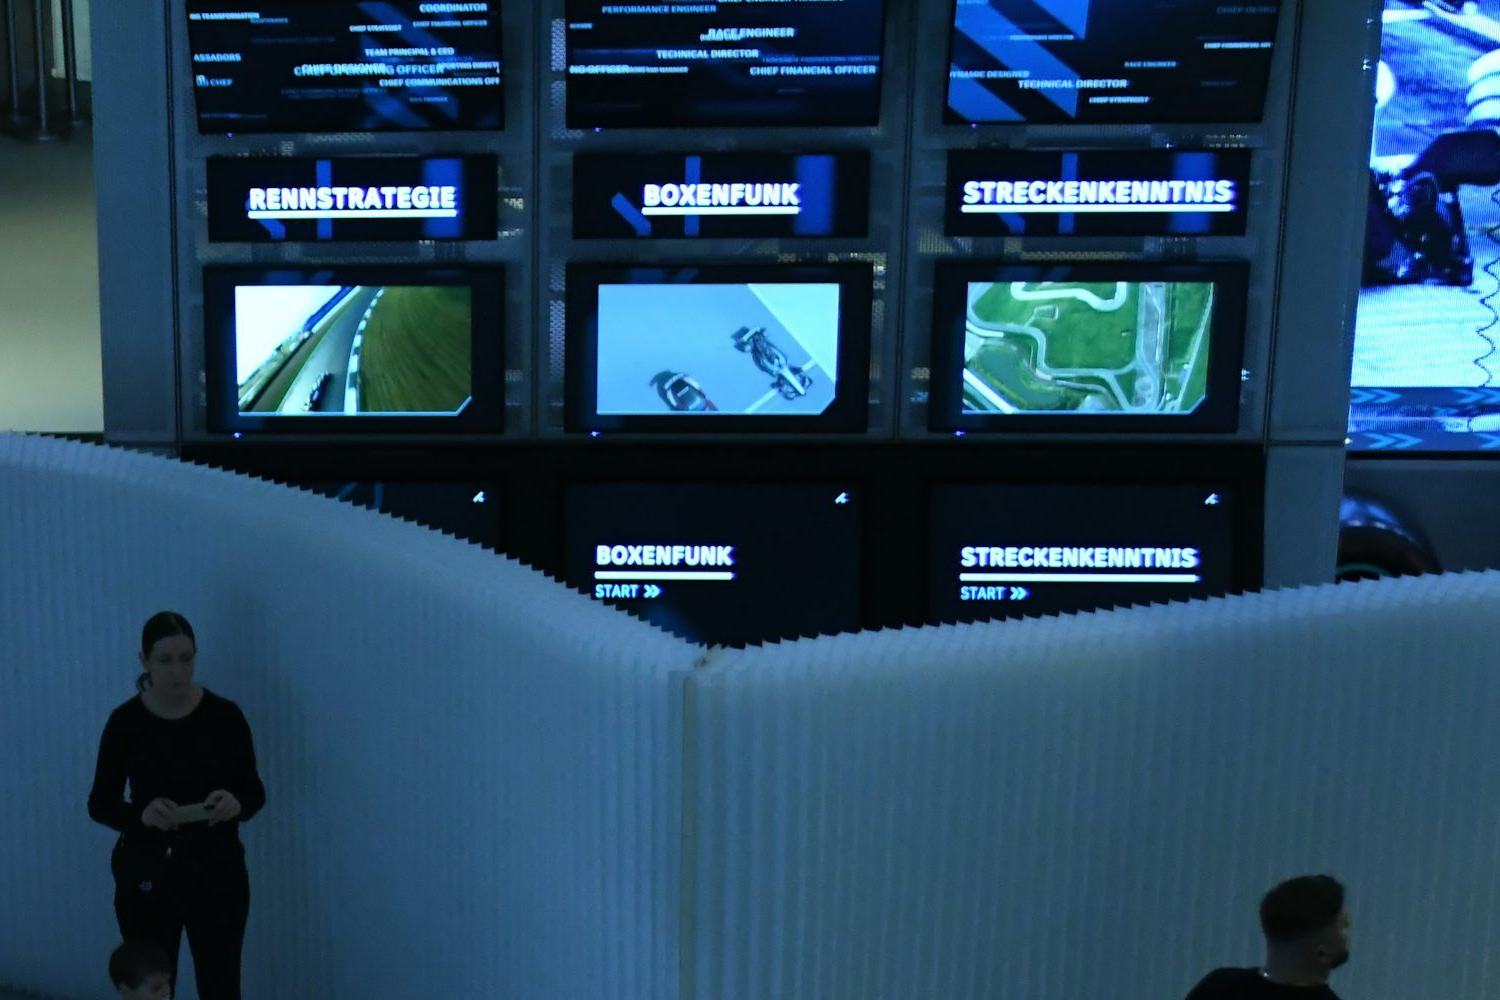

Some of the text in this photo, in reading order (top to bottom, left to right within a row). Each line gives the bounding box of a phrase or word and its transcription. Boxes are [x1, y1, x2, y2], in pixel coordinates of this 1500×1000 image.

[419, 3, 488, 13] COORDINATOR
[602, 5, 716, 14] PERFORMANCE ENGINEER
[708, 29, 738, 38] RACE
[740, 28, 795, 38] ENGINEER
[365, 49, 388, 57] TEAM
[389, 48, 429, 56] PRINCIPAL
[437, 47, 455, 55] CEO
[656, 49, 759, 59] TECHNICAL DIRECTOR
[396, 64, 445, 75] OFFICER
[750, 65, 877, 76] CHIEF FINANCIAL OFFICER
[986, 70, 1030, 78] DESIGNER
[379, 79, 404, 87] CHIEF
[405, 77, 483, 87] COMMUNICATIONS
[1018, 79, 1129, 89] TECHNICAL DIRECTOR
[250, 186, 456, 210] RENNSTRATEGIE
[643, 184, 800, 206] BOXENFUNK
[963, 181, 1234, 204] STRECKENKENNTNIS
[596, 544, 733, 566] BOXENFUNK
[960, 546, 1198, 568] STRECKENKENNTNIS
[595, 584, 638, 598] START
[960, 586, 1004, 600] START
